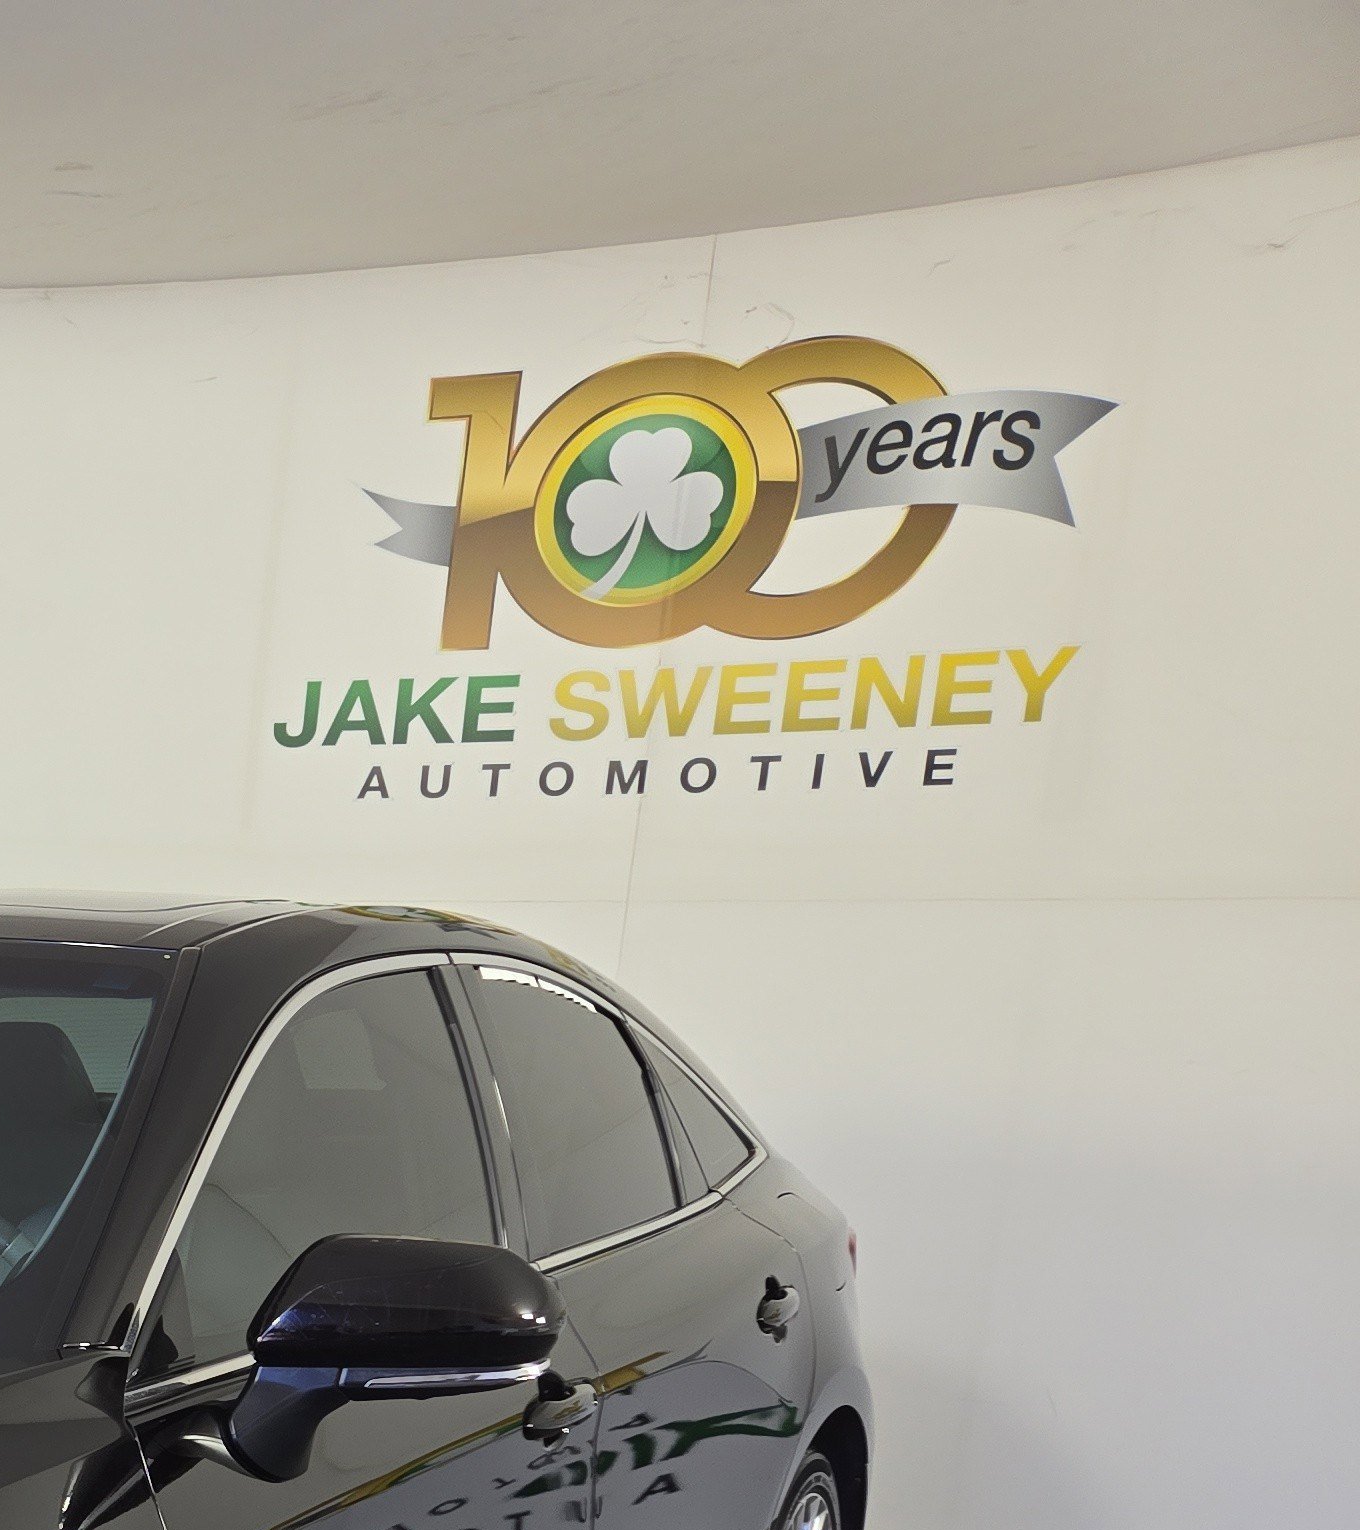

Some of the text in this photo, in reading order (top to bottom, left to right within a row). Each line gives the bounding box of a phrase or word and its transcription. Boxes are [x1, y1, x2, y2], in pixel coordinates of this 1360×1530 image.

[427, 334, 962, 650] 100
[814, 405, 1042, 505] years
[272, 645, 1081, 749] JAKE SWEENEY
[357, 747, 960, 801] AUTOMOTIVE
